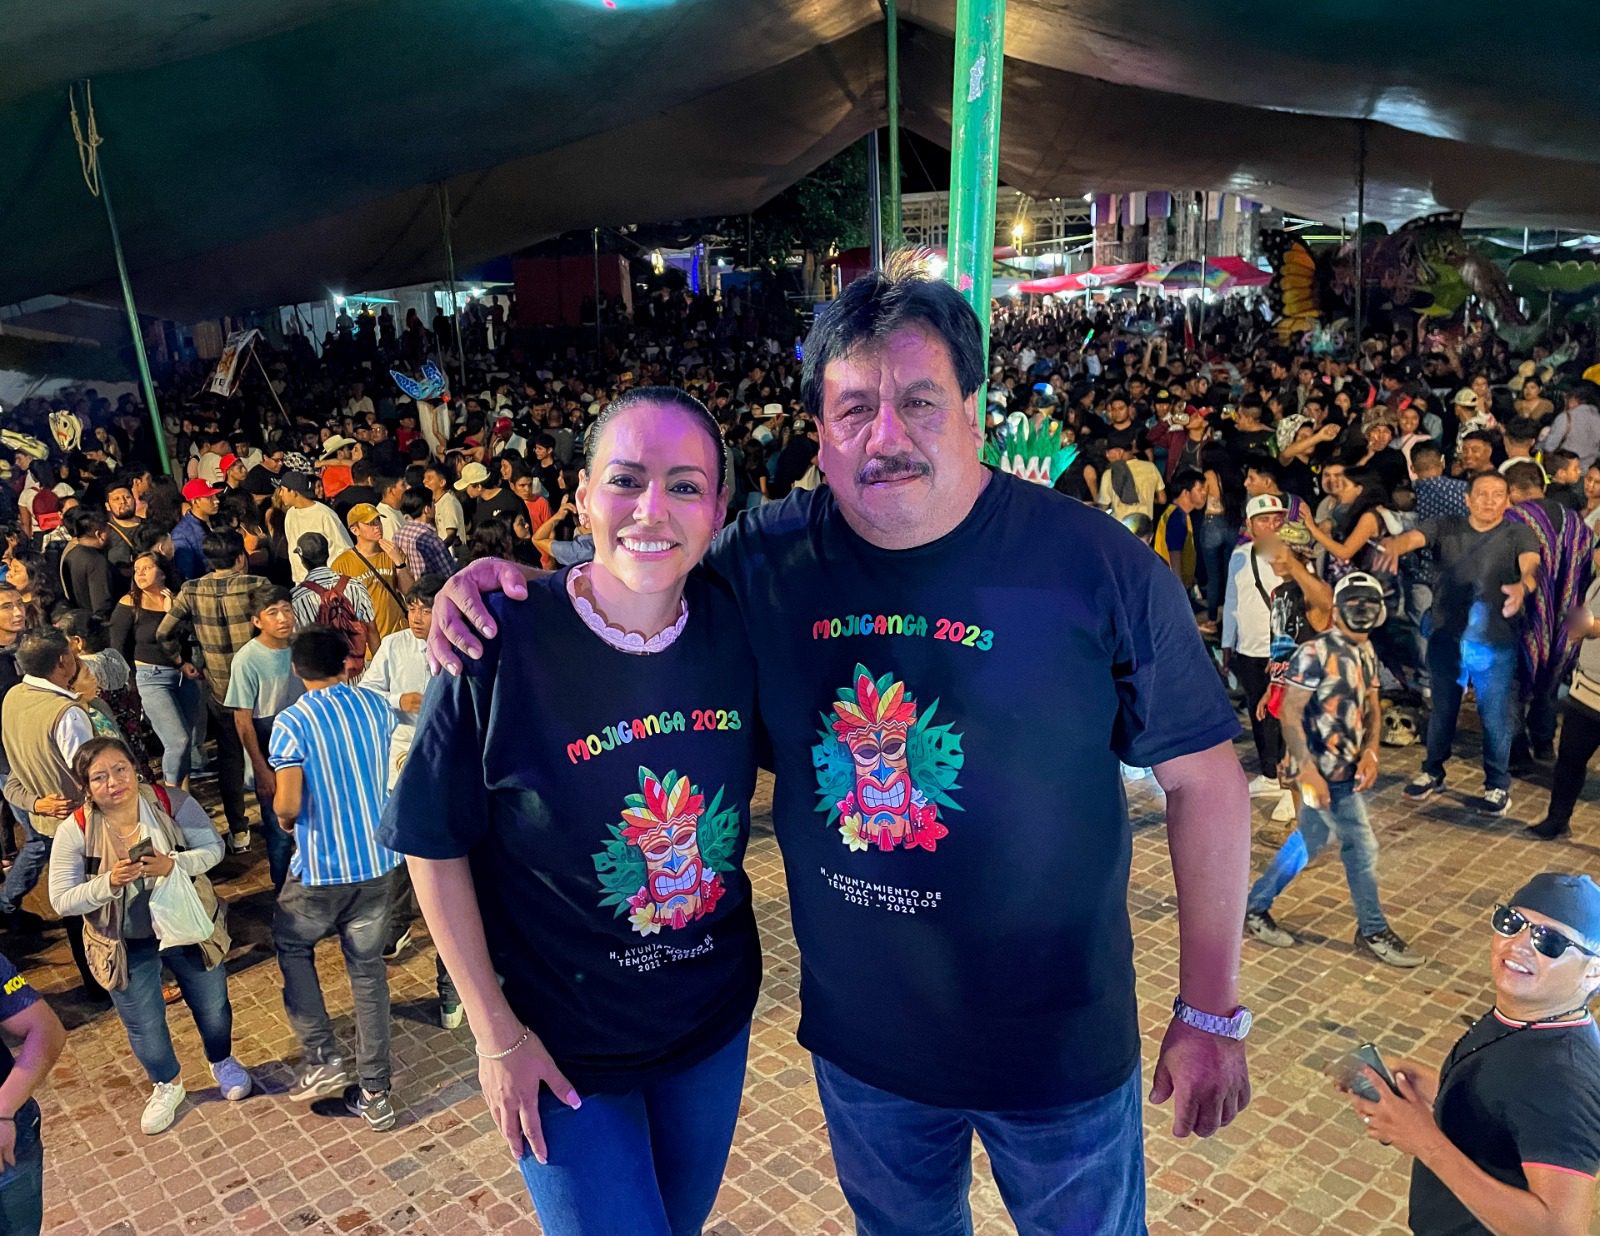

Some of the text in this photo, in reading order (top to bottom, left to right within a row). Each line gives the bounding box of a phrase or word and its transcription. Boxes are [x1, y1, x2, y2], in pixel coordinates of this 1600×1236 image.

[812, 613, 995, 651] MOJIGANGA 2023
[566, 709, 742, 765] MOJIGANGA 2023
[820, 866, 942, 900] H. AYUNTAMIENTO DE
[844, 893, 870, 907] 2022
[886, 903, 916, 914] 2024
[878, 893, 938, 908] MORELOS
[609, 951, 620, 960] H.
[637, 959, 661, 972] 2022
